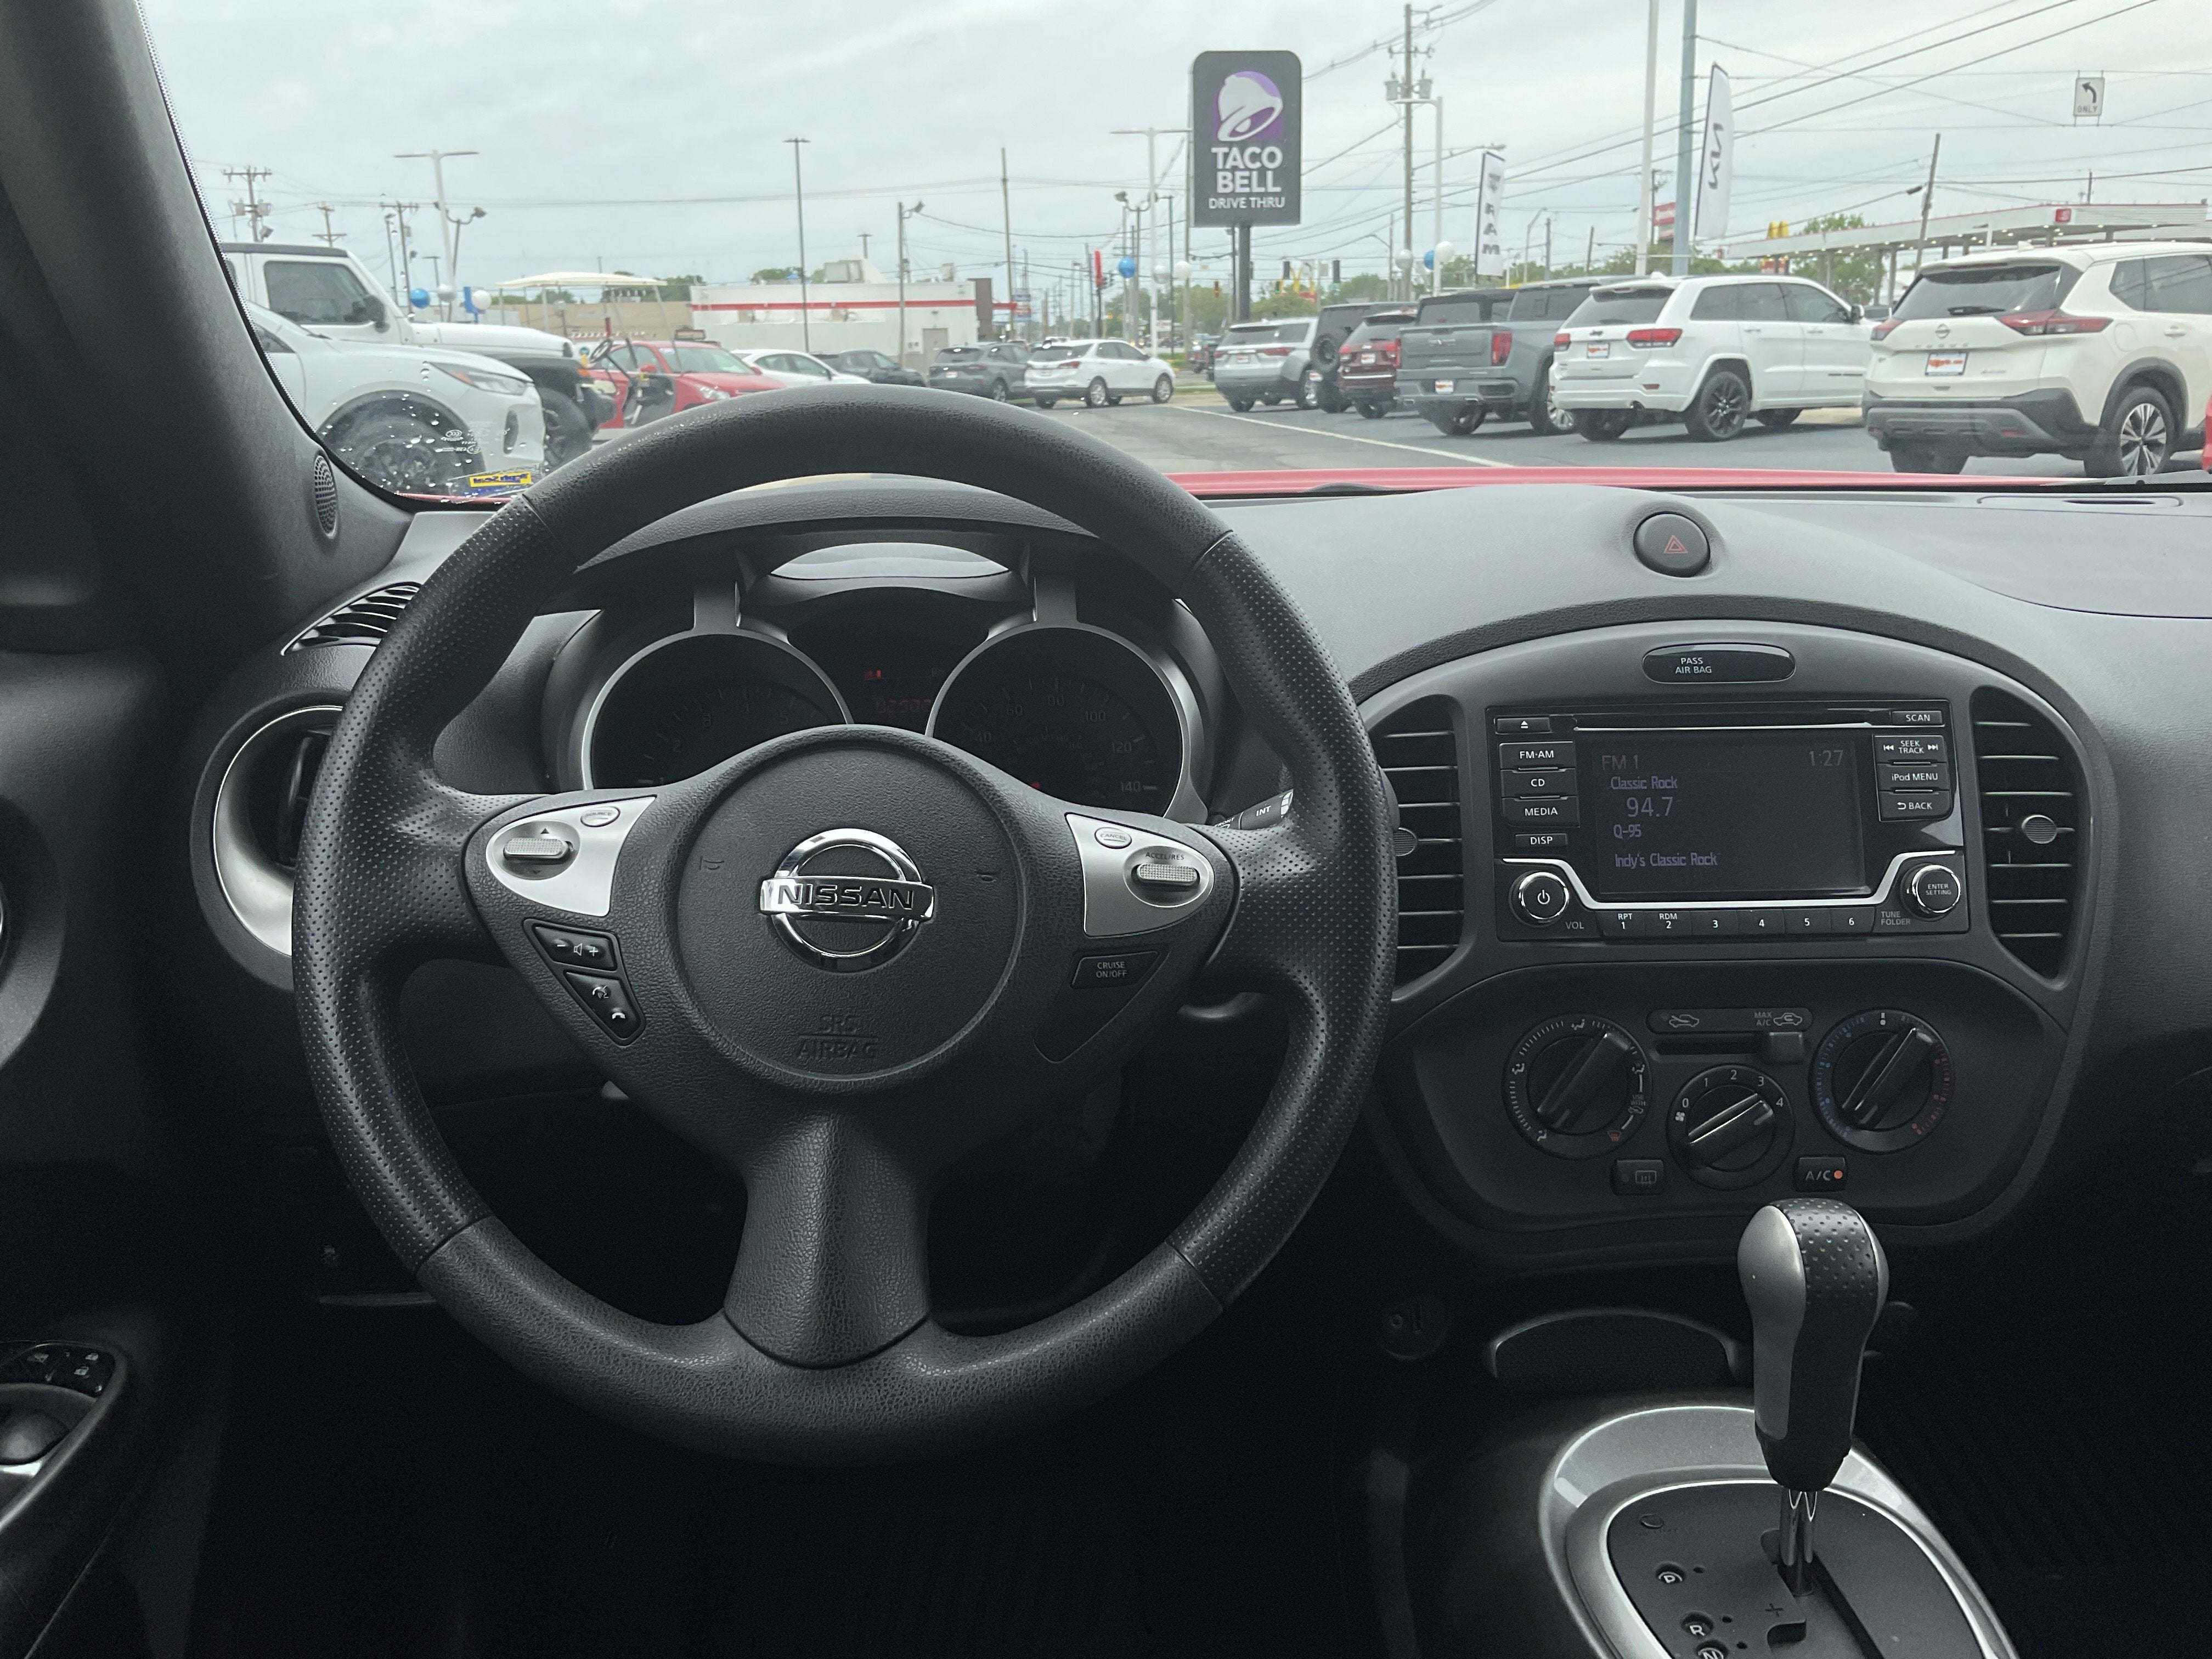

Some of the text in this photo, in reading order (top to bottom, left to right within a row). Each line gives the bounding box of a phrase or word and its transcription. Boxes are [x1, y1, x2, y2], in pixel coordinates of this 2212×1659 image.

[1211, 147, 1283, 169] TACO
[1216, 171, 1282, 193] BELL
[1209, 197, 1285, 208] DRIVE THRU
[1482, 202, 1500, 255] RAM
[1601, 754, 1638, 770] FM 1
[1809, 749, 1843, 766] 1:27
[1120, 781, 1141, 792] 140
[1531, 778, 1545, 787] CD
[1611, 776, 1678, 789] Classic Rock
[1256, 805, 1272, 817] INT
[1525, 807, 1558, 816] MEDIA
[1626, 797, 1673, 817] 94.7
[1100, 832, 1128, 840] CANCEL
[1613, 824, 1641, 839] Q-95
[1530, 837, 1553, 845] DISP
[1615, 852, 1718, 869] Indy's Classic Rock
[777, 883, 915, 910] NISSAN
[1712, 920, 1718, 928] 3
[1759, 919, 1765, 927] 4
[1804, 918, 1810, 926] 5
[1849, 917, 1854, 926] 6
[1097, 961, 1125, 969] CRUISE
[1096, 970, 1127, 979] ON/OFF
[1730, 1070, 1737, 1080] 2
[1704, 1078, 1708, 1087] 1
[1758, 1076, 1764, 1087] 3
[1682, 1098, 1689, 1108] 0
[1776, 1097, 1784, 1107] 4
[1805, 1170, 1831, 1181] A/C
[1690, 1625, 1706, 1636] R
